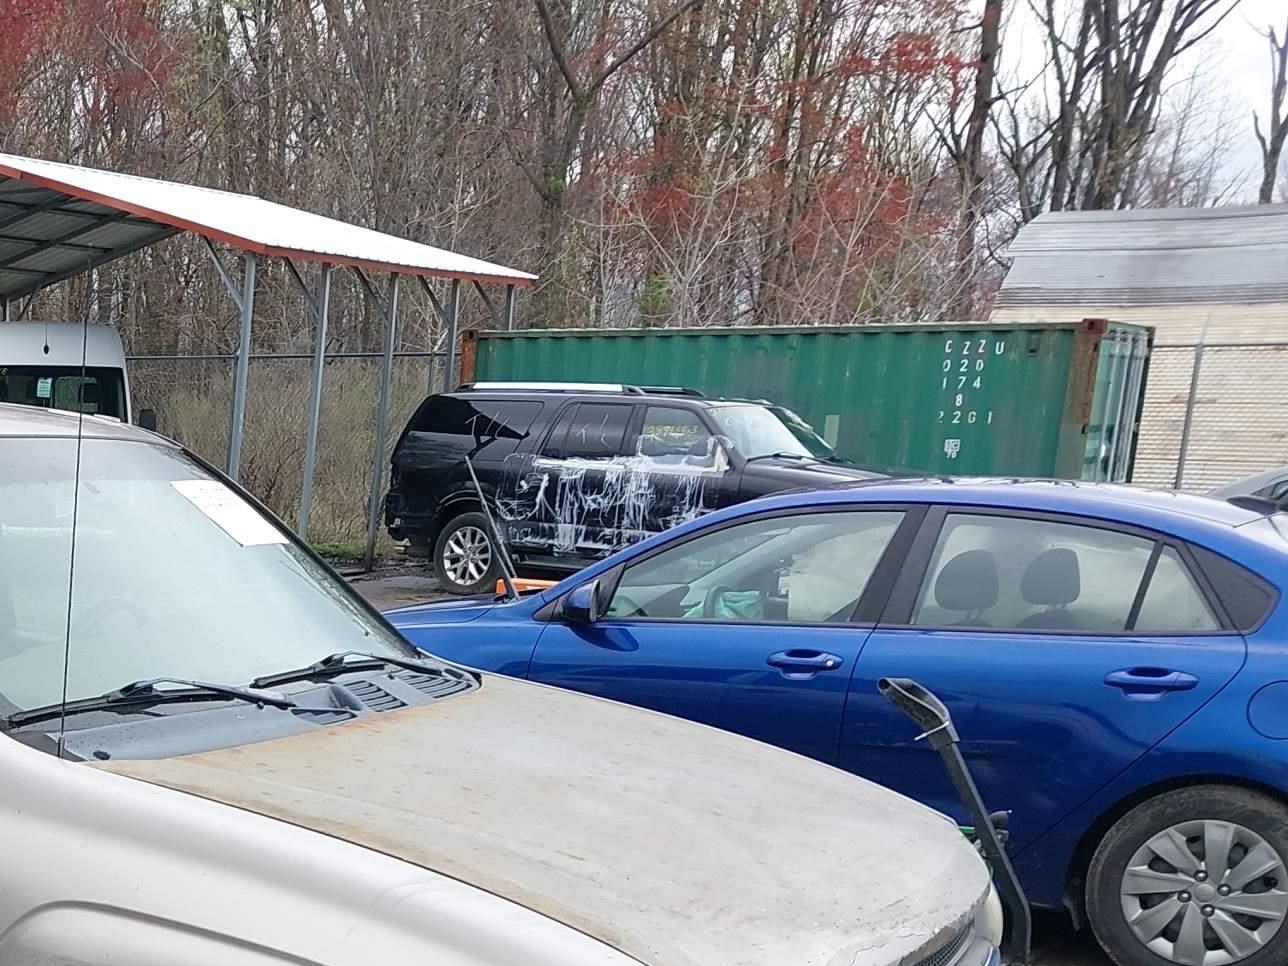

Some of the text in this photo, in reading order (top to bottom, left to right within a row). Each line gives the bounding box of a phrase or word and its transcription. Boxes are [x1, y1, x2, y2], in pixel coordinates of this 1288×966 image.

[944, 339, 1005, 355] CZZU
[942, 359, 984, 372] 020
[942, 376, 982, 389] 174
[955, 394, 963, 407] 8
